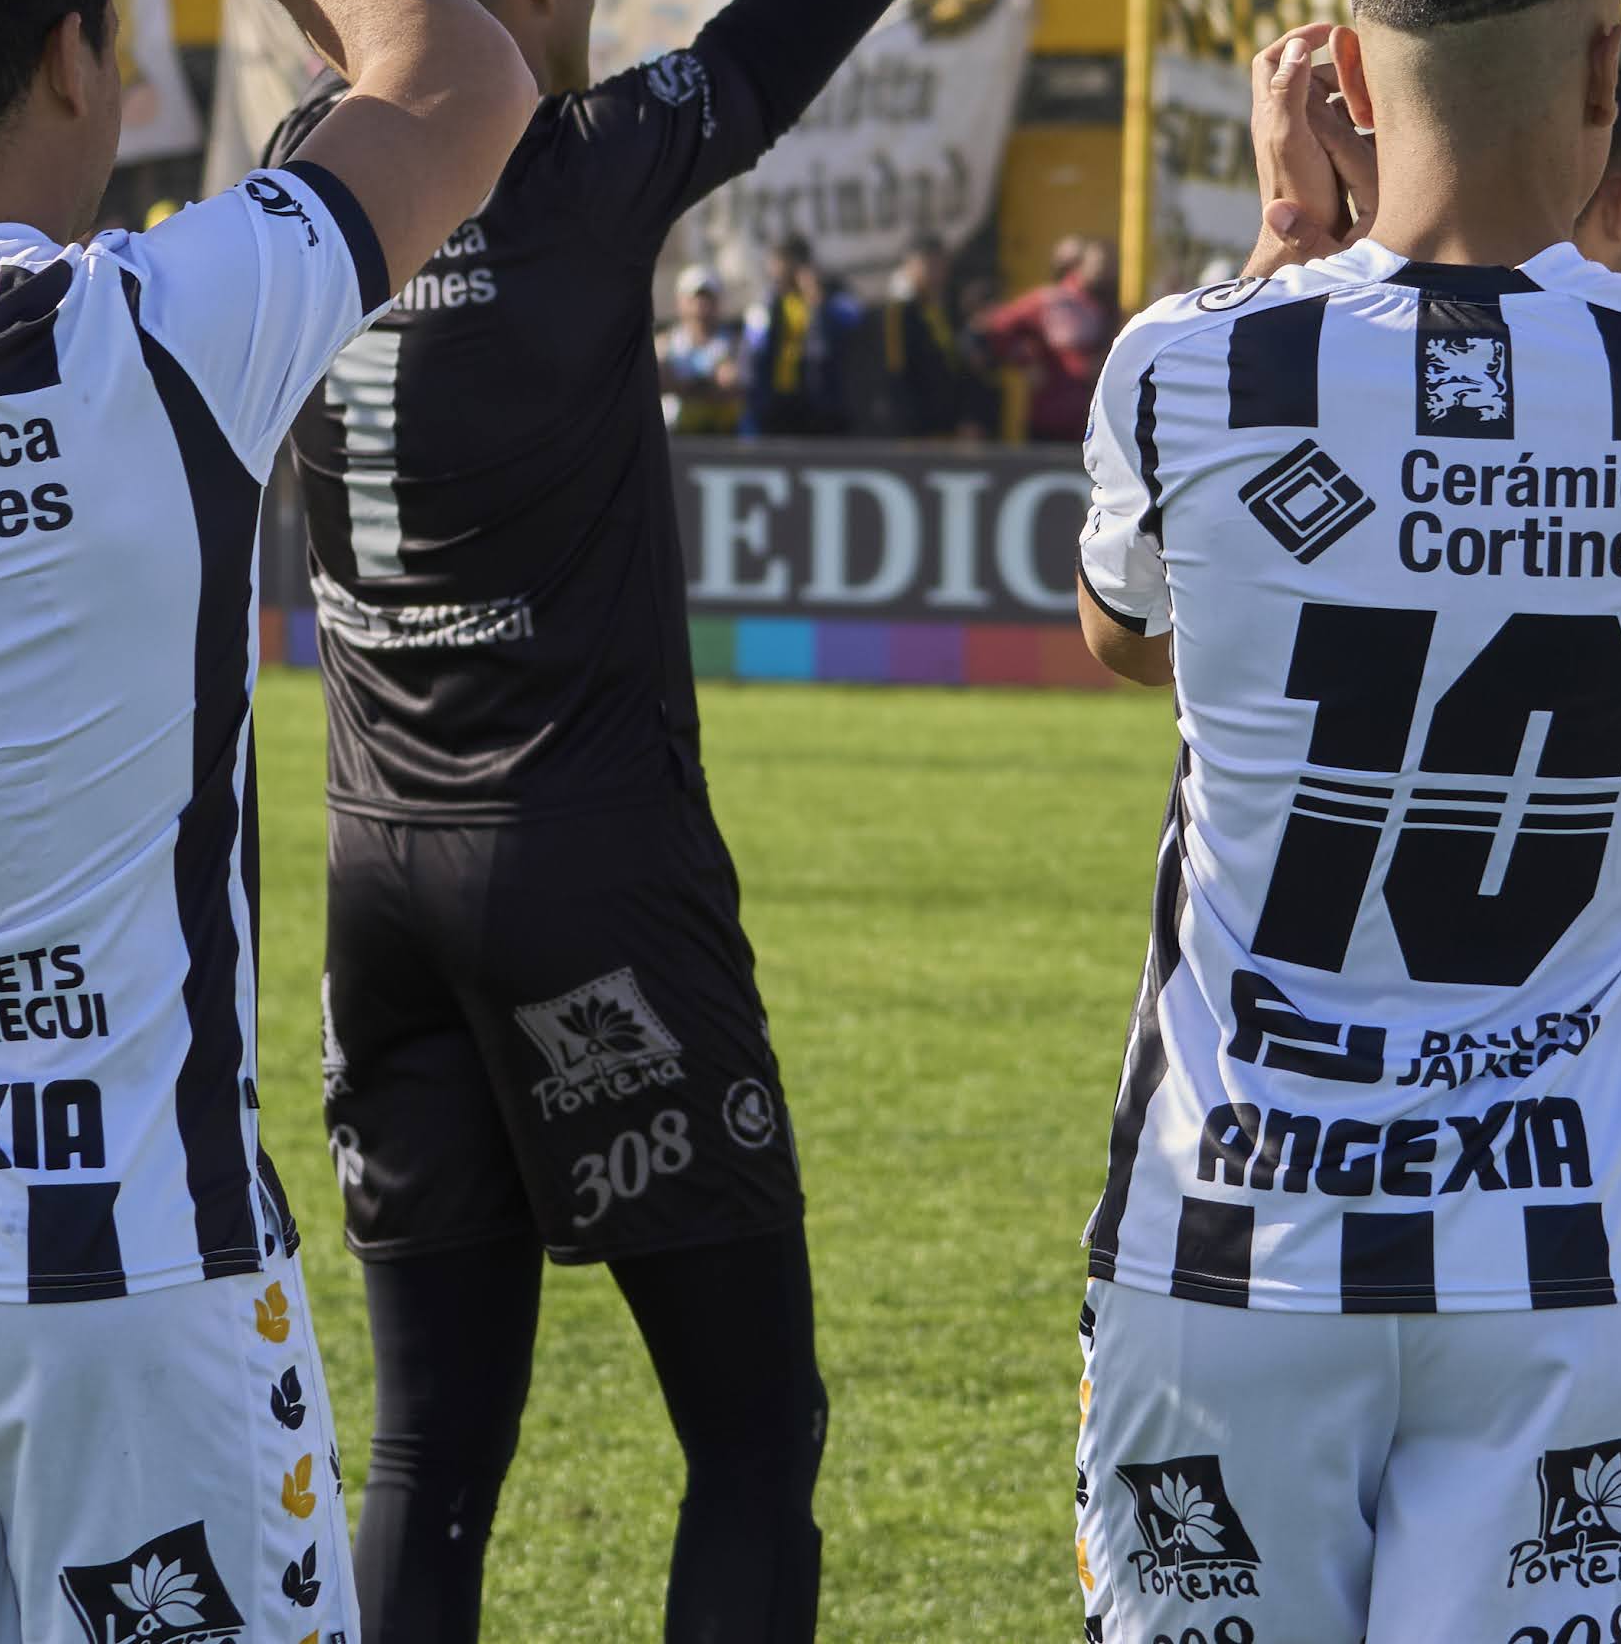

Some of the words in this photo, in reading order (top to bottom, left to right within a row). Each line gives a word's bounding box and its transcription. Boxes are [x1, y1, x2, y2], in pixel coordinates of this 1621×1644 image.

[325, 330, 404, 578] 1
[571, 1108, 693, 1228] 308
[1196, 1096, 1593, 1198] ANGEXIA
[1149, 1512, 1191, 1550] La
[1549, 1496, 1601, 1535] La
[1127, 1548, 1262, 1602] Porteña
